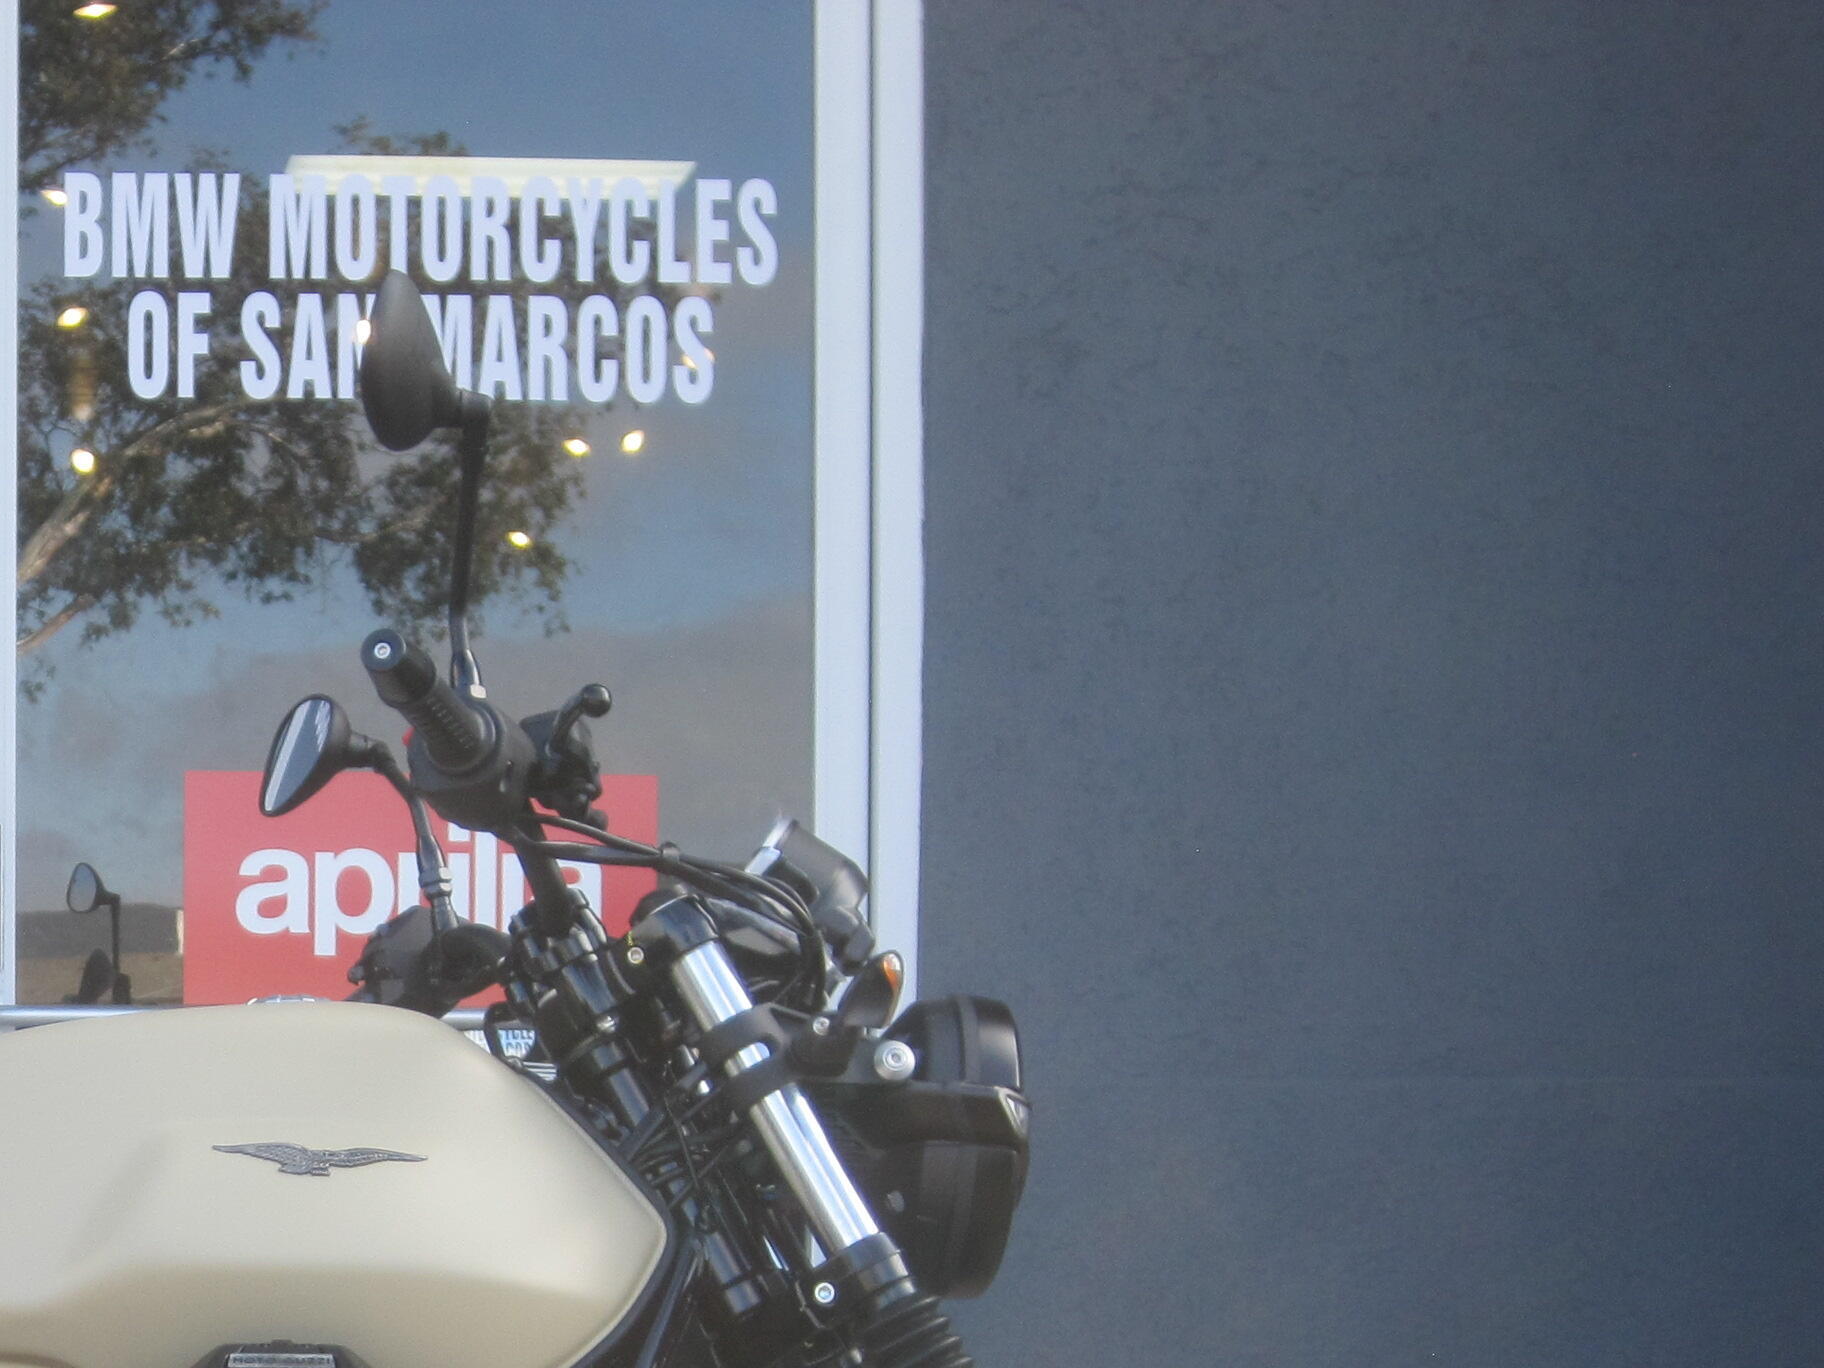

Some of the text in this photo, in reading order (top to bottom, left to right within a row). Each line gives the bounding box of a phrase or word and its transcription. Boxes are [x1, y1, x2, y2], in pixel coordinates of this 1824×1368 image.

[63, 172, 778, 286] BMW MOTORCYCLES
[127, 290, 212, 399] OF
[420, 294, 716, 405] MARCOS
